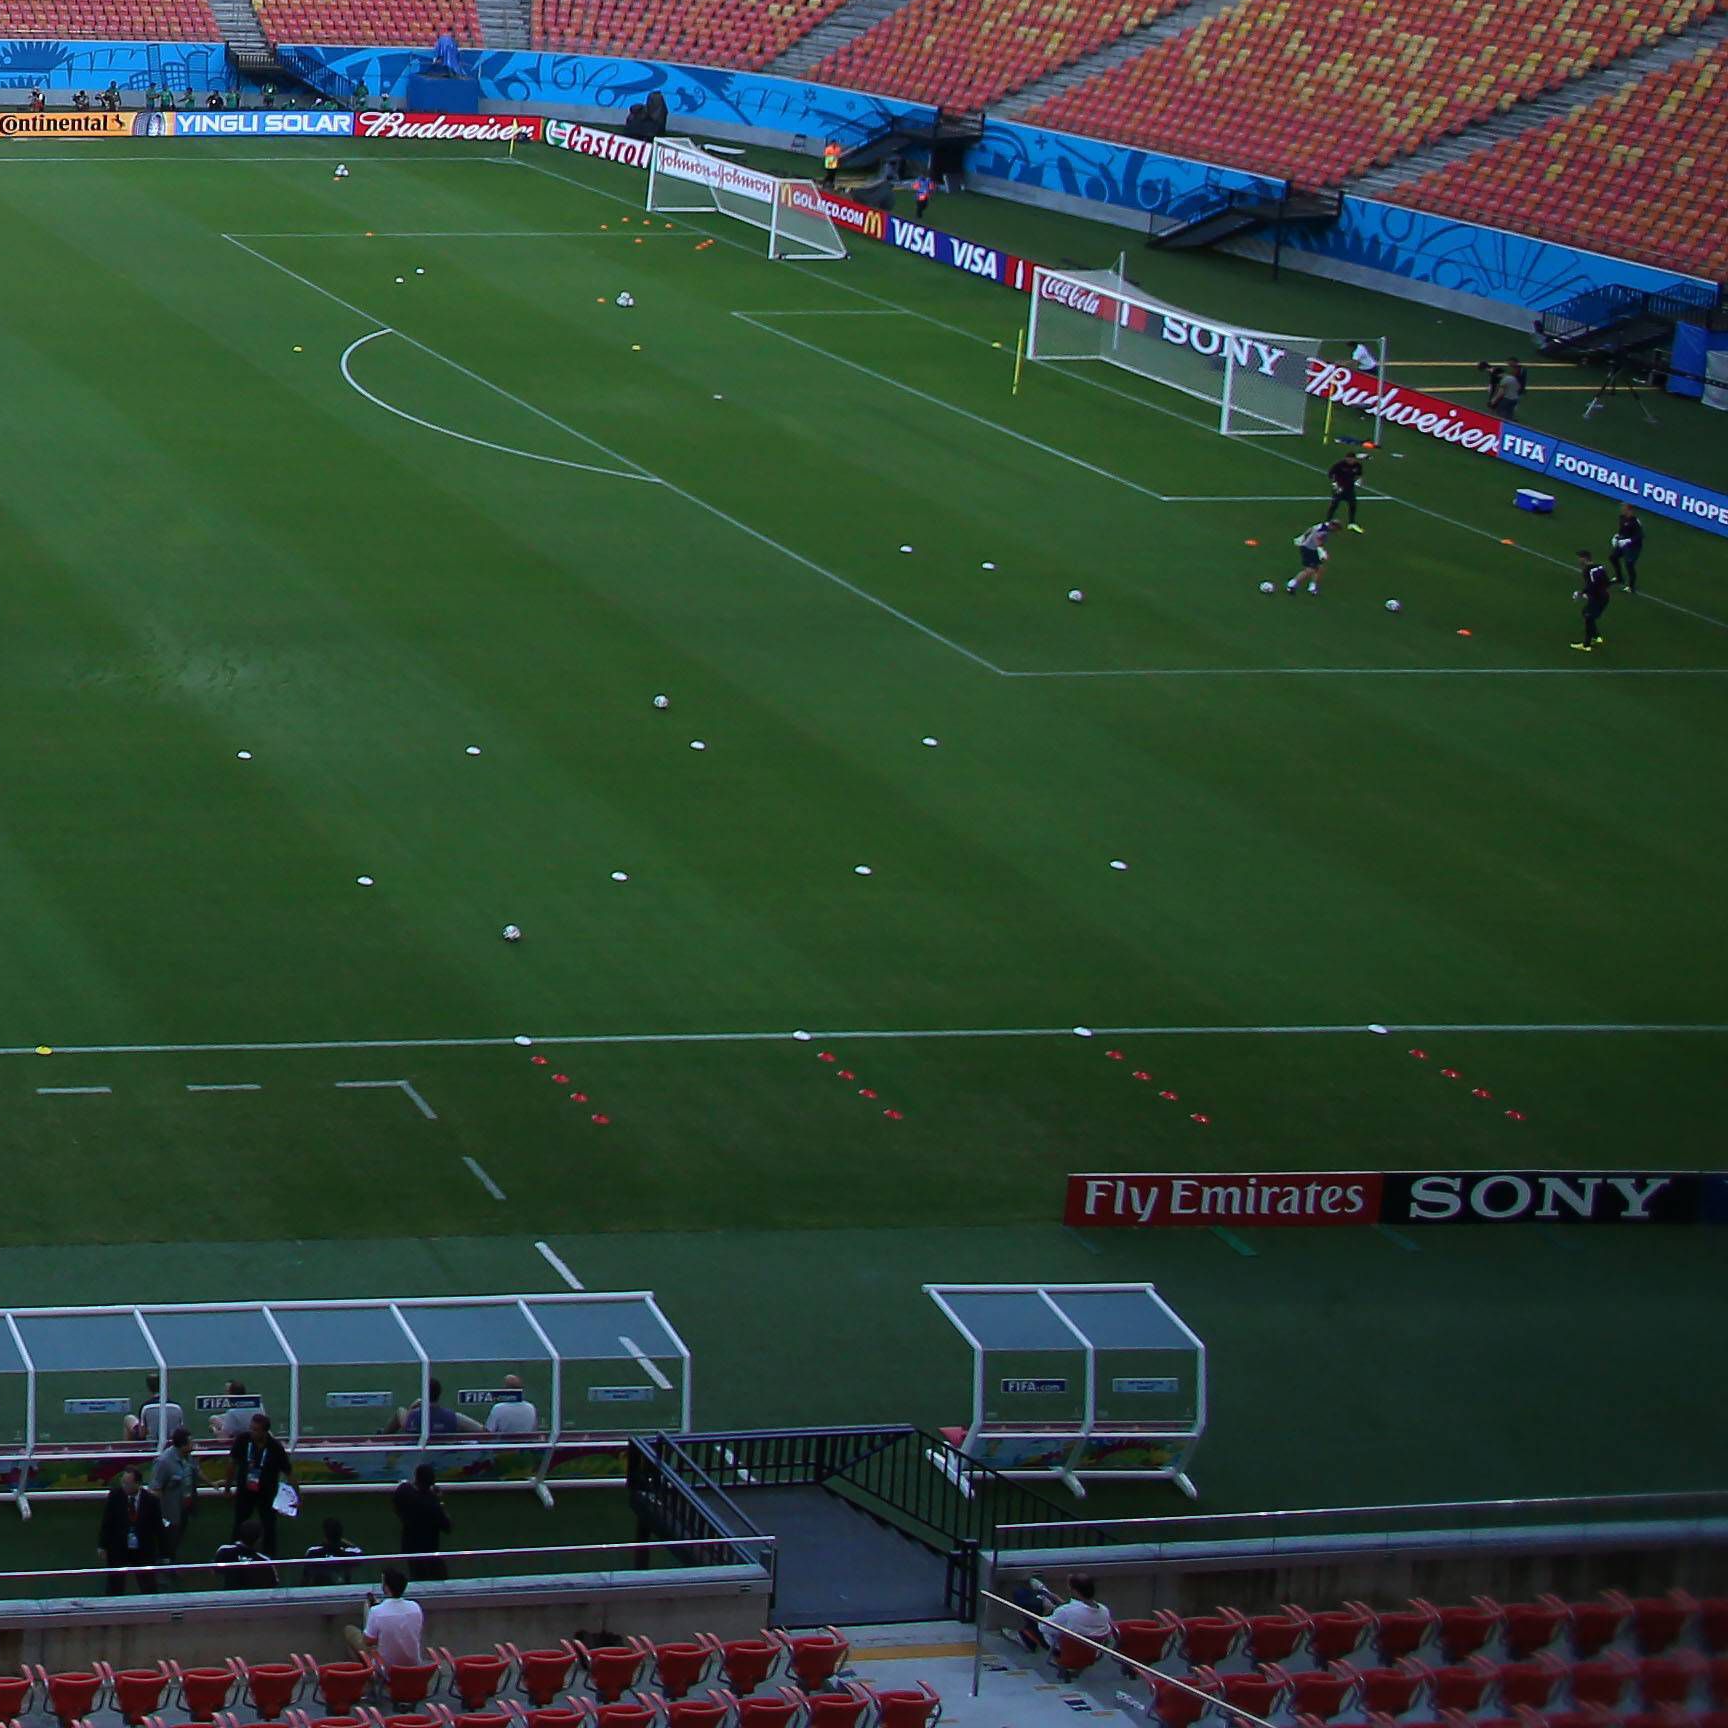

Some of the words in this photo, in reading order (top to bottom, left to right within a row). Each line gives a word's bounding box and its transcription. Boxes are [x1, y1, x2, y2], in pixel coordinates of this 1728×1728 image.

[176, 115, 259, 133] YINGLI
[264, 114, 351, 133] SOLAR
[359, 112, 535, 141] Budweiser
[567, 123, 647, 168] Castrol
[793, 190, 864, 227] GOL.MCD.COM
[890, 216, 935, 259] VISA
[950, 237, 998, 280] VISA
[1162, 315, 1286, 376] SONY
[1305, 358, 1500, 454] Budweiser
[1502, 433, 1545, 464] FIFA
[1554, 452, 1639, 495] FOOTBALL
[1643, 482, 1678, 507] FOR
[1682, 495, 1728, 525] HOPE
[1084, 1180, 1159, 1223] Fly
[1170, 1178, 1364, 1214] Emirates
[1409, 1175, 1670, 1218] SONY
